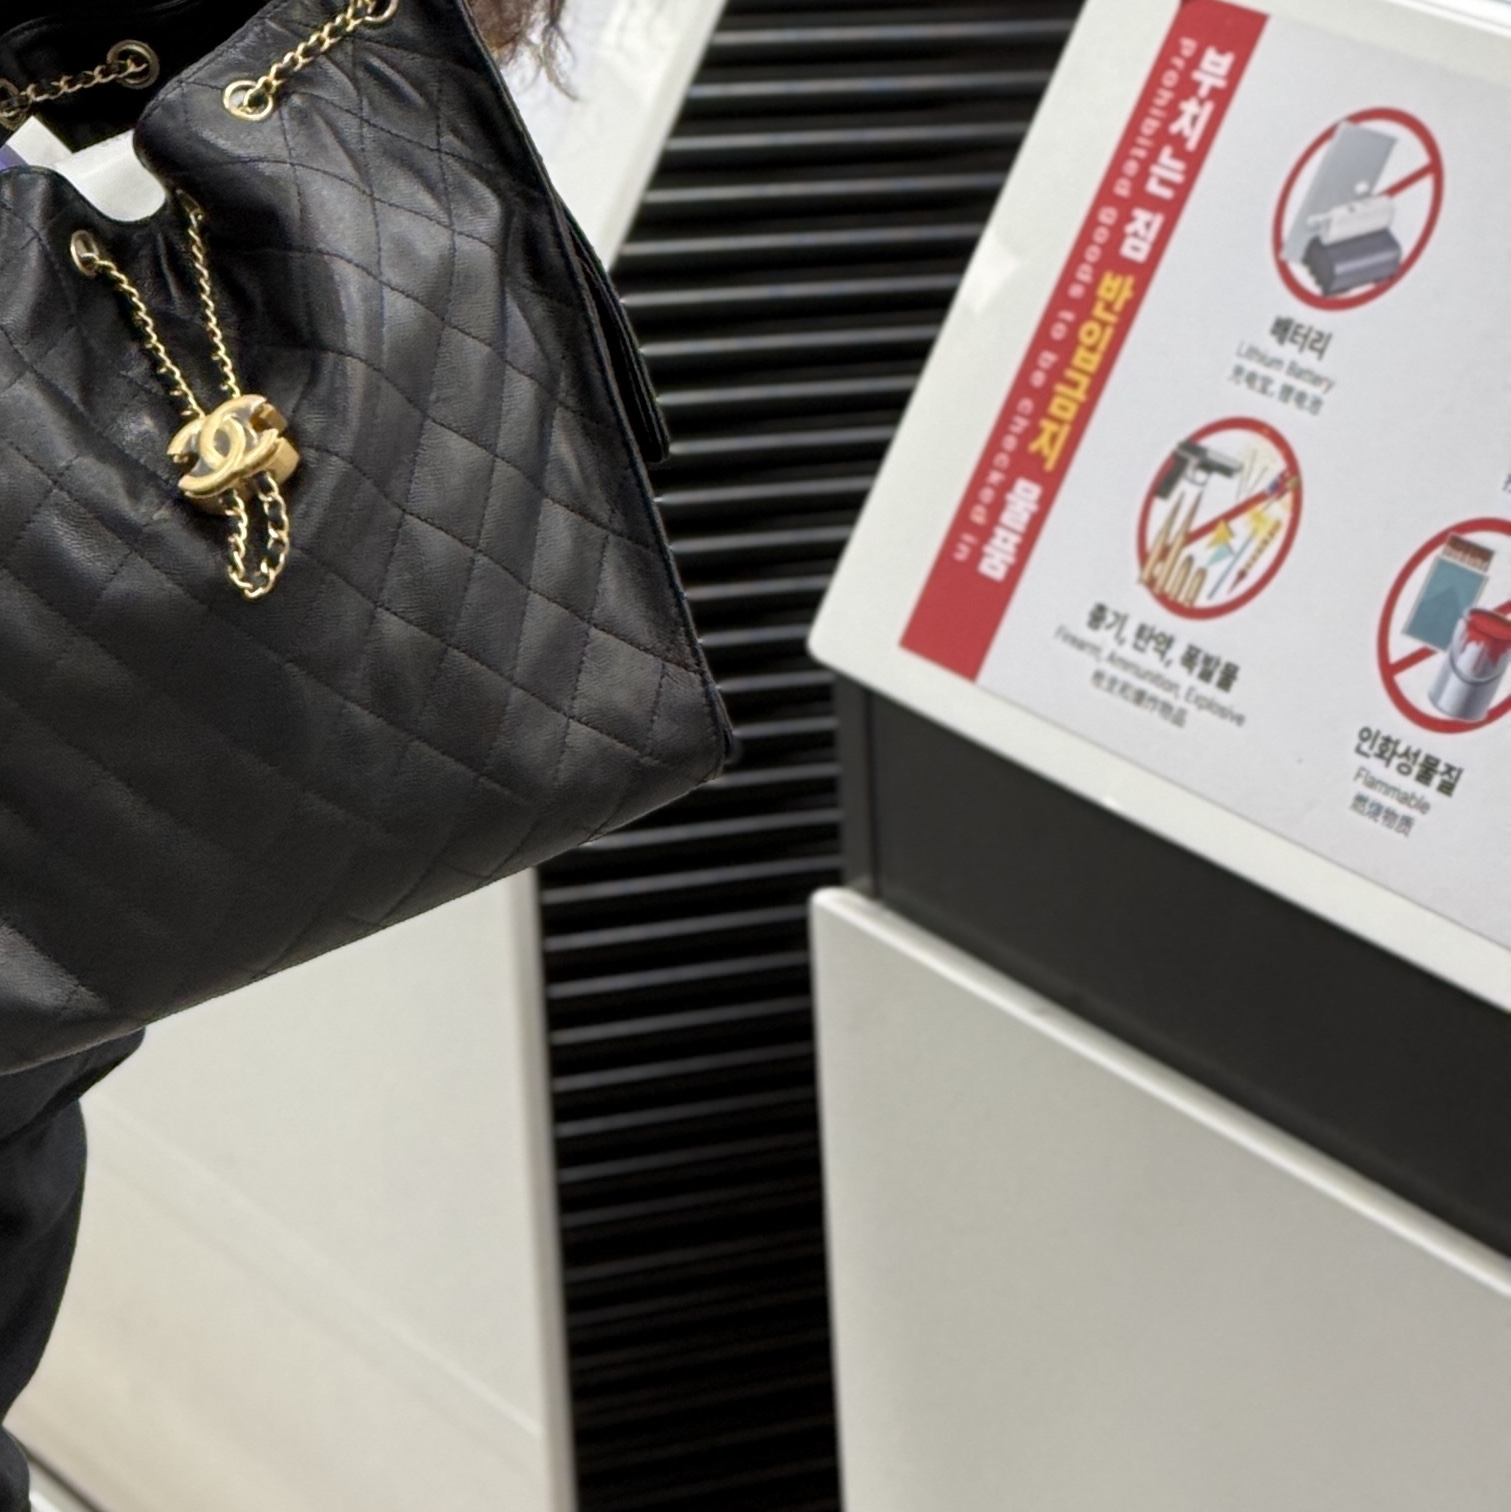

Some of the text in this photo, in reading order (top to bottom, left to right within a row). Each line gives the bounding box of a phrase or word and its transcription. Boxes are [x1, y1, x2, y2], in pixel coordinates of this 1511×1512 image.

[952, 37, 1198, 563] Prohibited goods to be checked in
[977, 45, 1236, 582] 부치는 짐 반입금지 물품
[1269, 314, 1333, 362] 배터리
[1353, 765, 1432, 816] Flammable
[1354, 726, 1465, 799] 인화성물질
